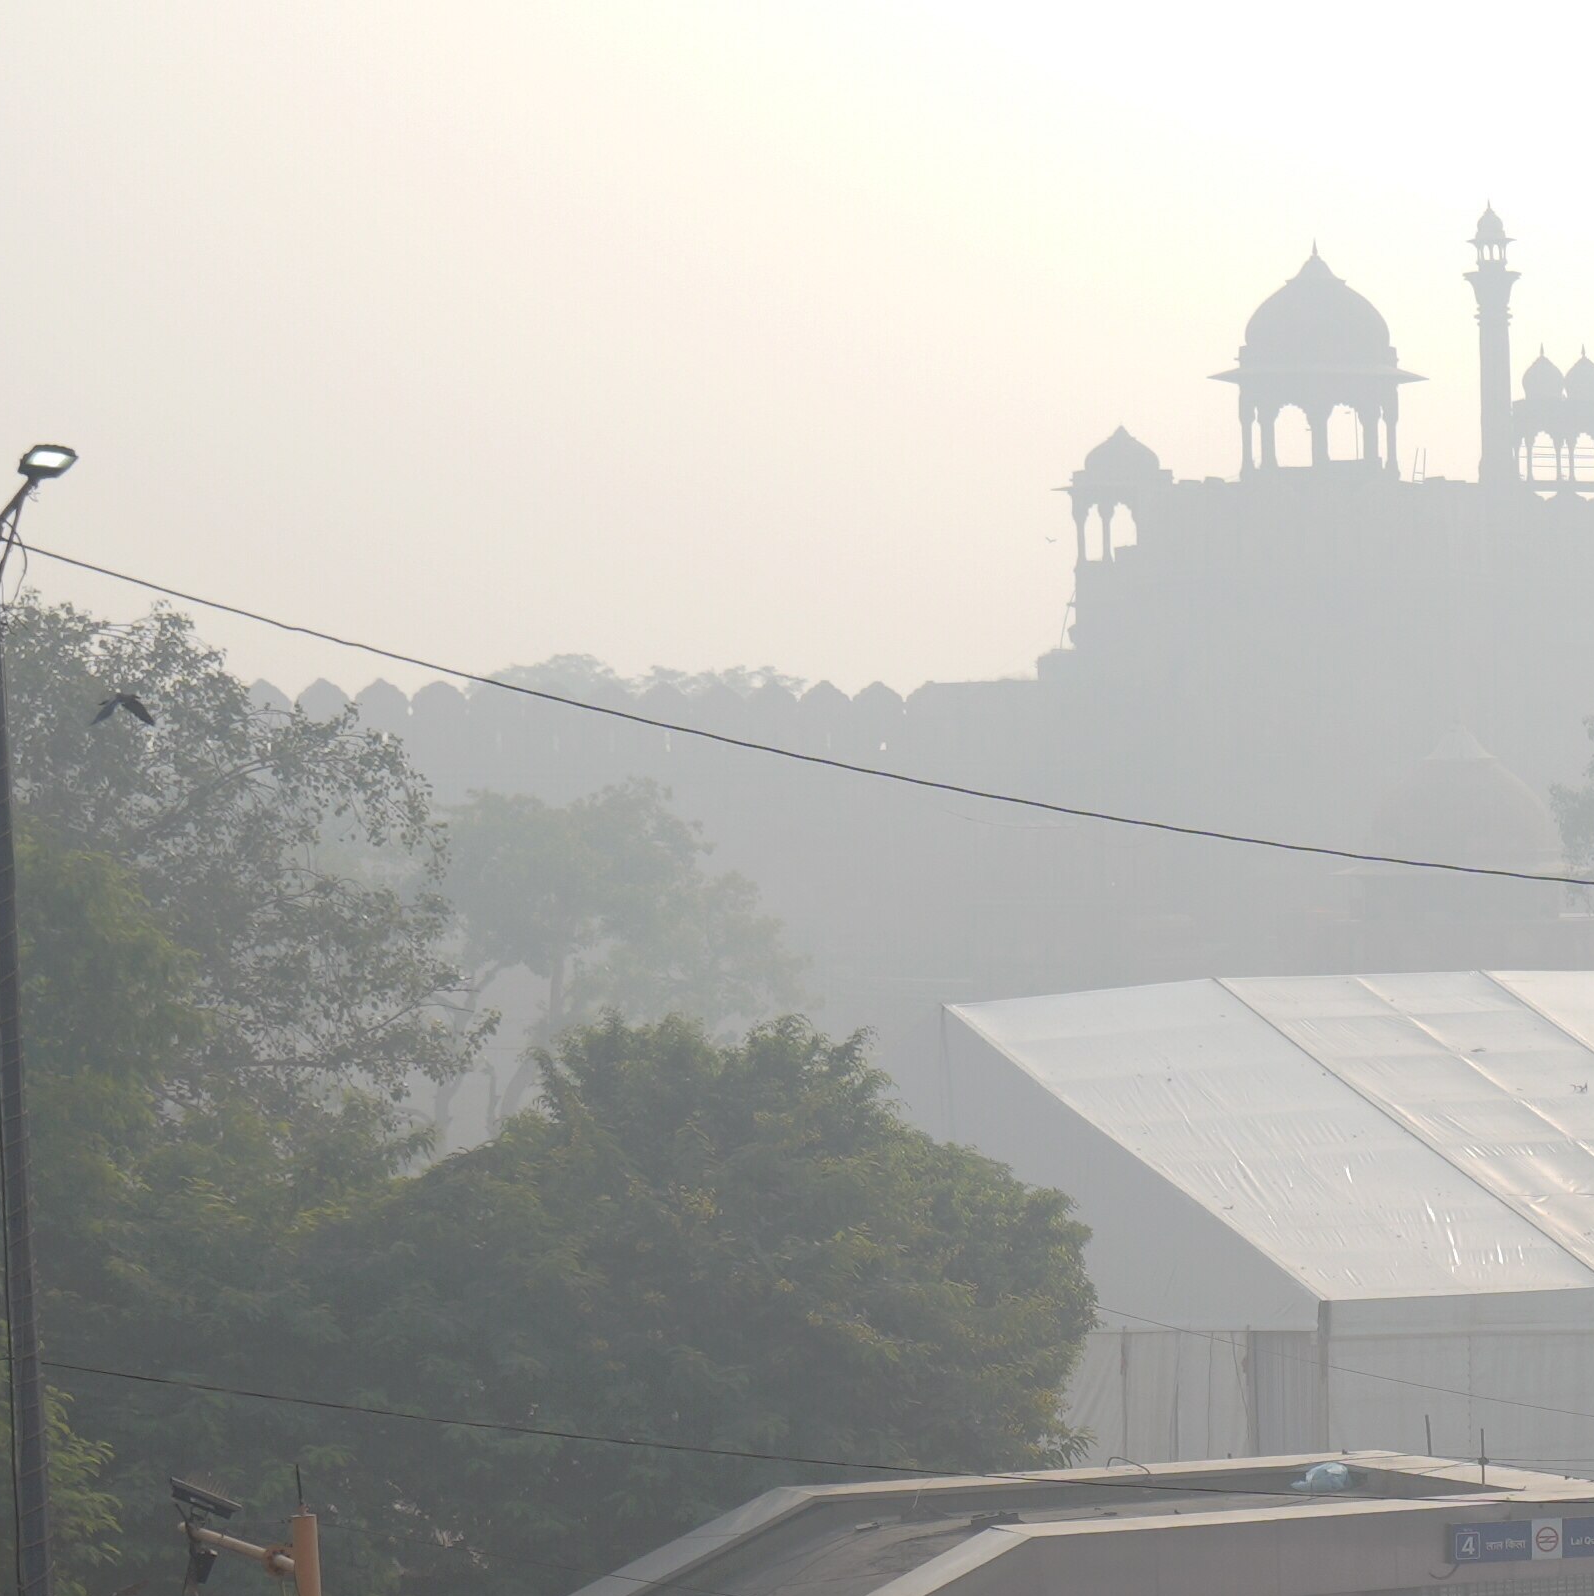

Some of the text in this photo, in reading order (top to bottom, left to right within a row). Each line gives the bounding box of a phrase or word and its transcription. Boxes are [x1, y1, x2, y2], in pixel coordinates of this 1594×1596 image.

[1461, 1536, 1476, 1556] 4
[1485, 1537, 1526, 1552] लाल किला
